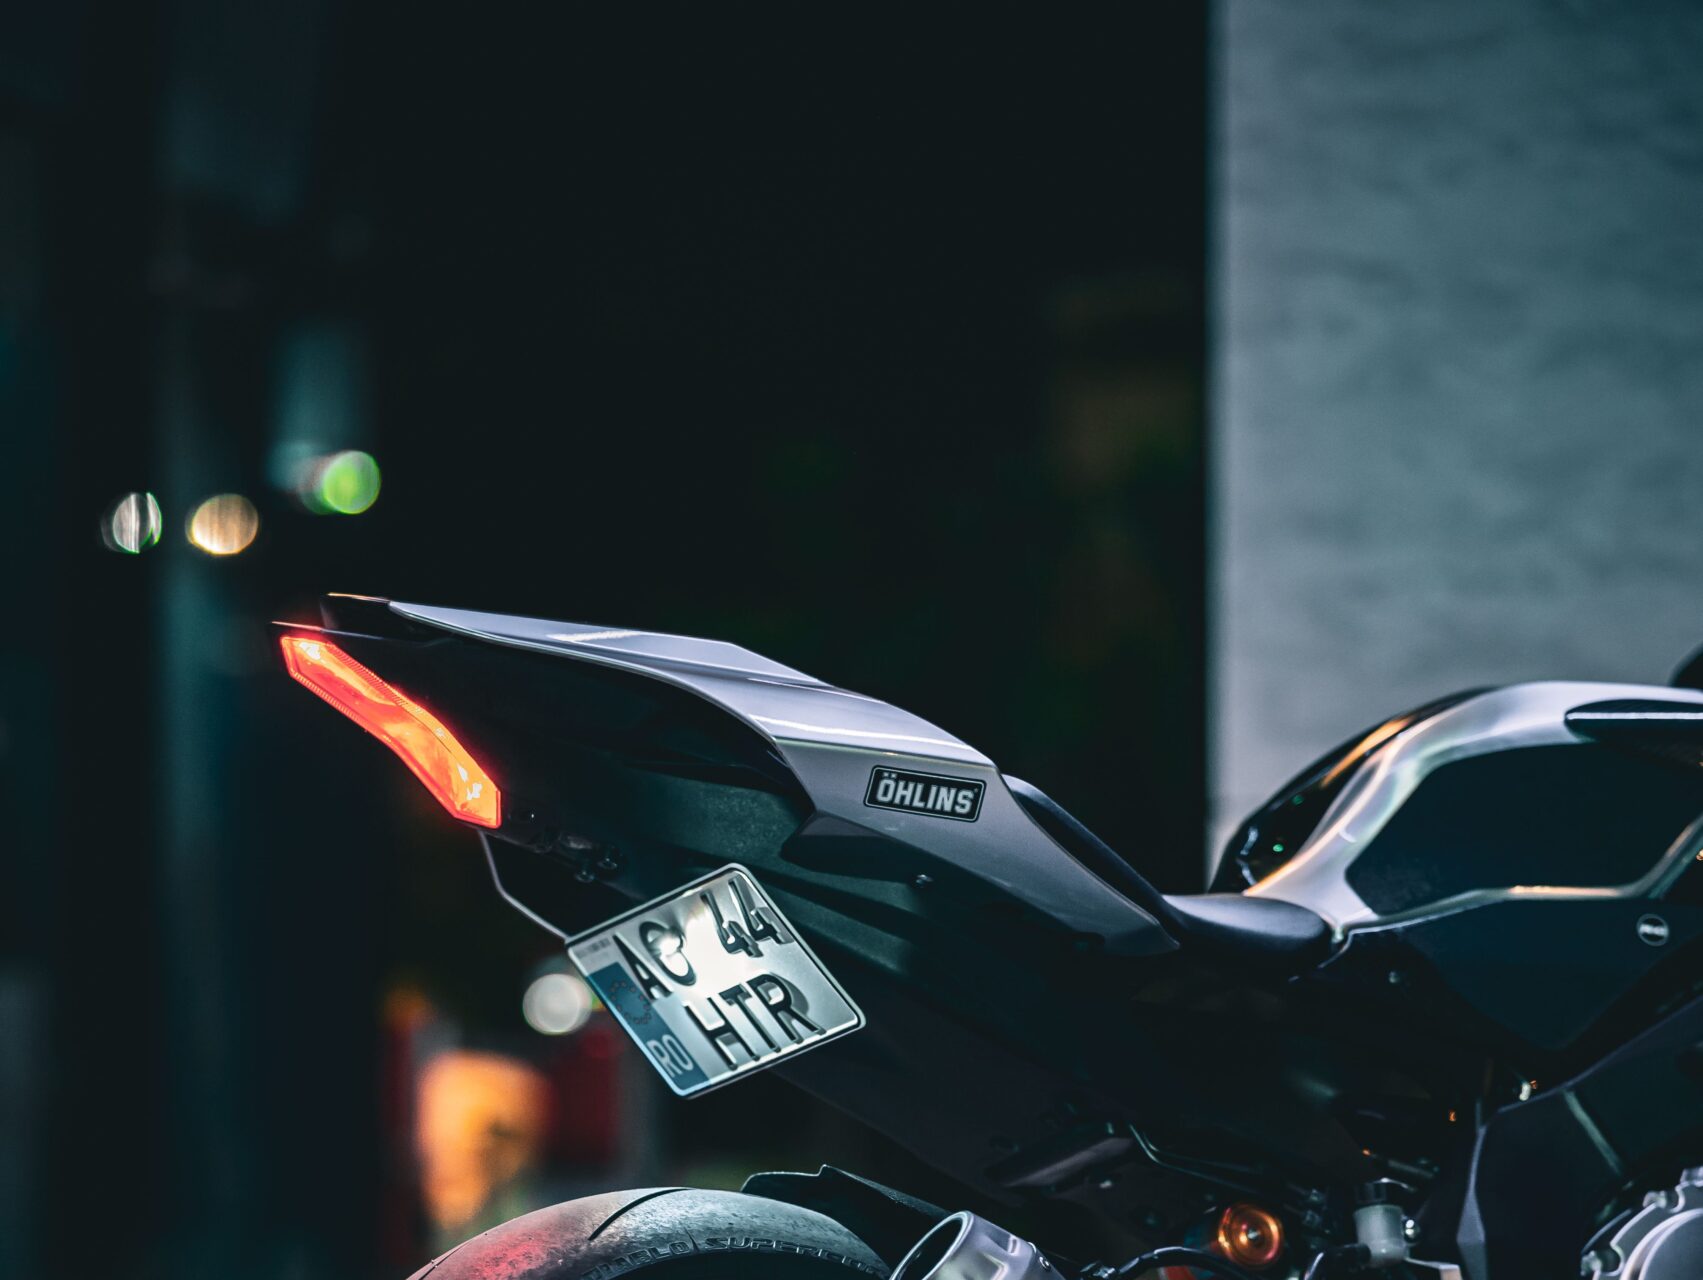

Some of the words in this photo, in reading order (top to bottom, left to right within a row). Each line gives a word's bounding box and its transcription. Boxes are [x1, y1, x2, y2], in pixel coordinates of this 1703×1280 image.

[875, 771, 975, 814] ÖHLINS
[700, 878, 796, 959] 44
[684, 973, 827, 1071] HTR
[646, 1034, 694, 1079] RO
